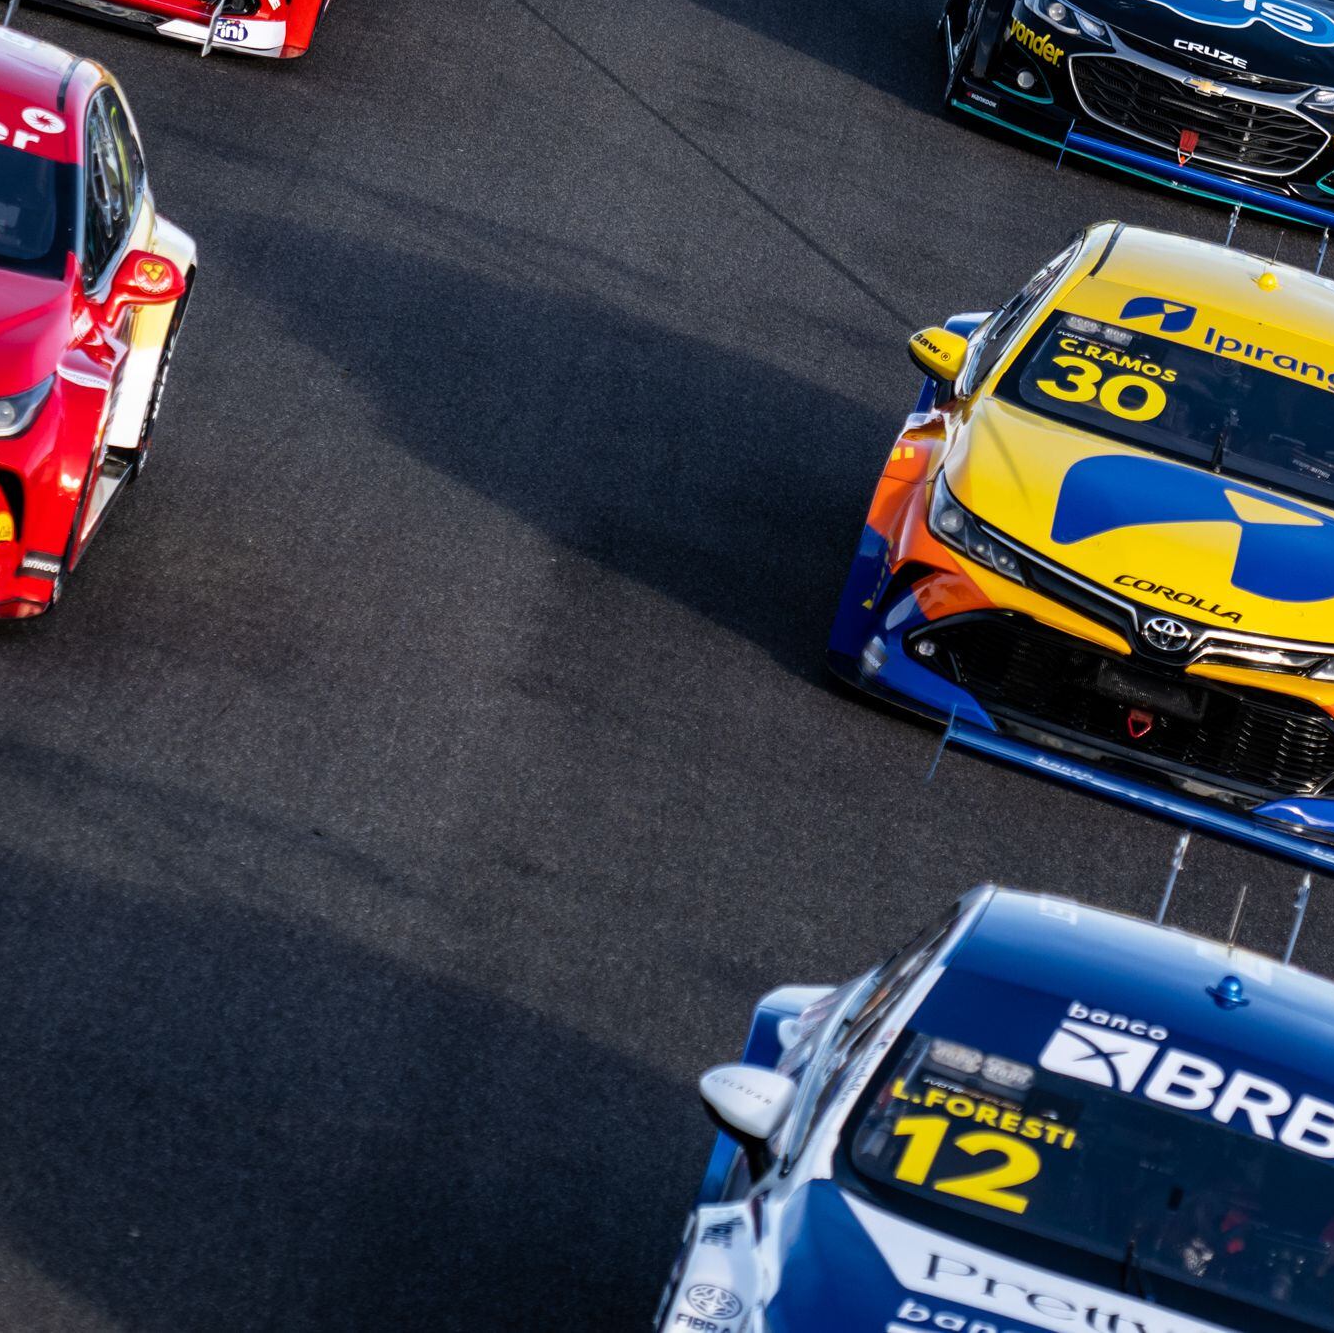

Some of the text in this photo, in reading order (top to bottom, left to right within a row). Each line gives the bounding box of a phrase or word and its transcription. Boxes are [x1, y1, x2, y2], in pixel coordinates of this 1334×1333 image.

[1011, 17, 1064, 68] vonder
[1174, 39, 1247, 69] CRUZE
[1060, 338, 1177, 385] C.RAMOS
[1037, 355, 1167, 423] 30
[1113, 574, 1243, 624] COROLLA
[1067, 1001, 1170, 1042] banco
[891, 1078, 1077, 1150] L.FORESTI
[894, 1115, 1042, 1215] 12
